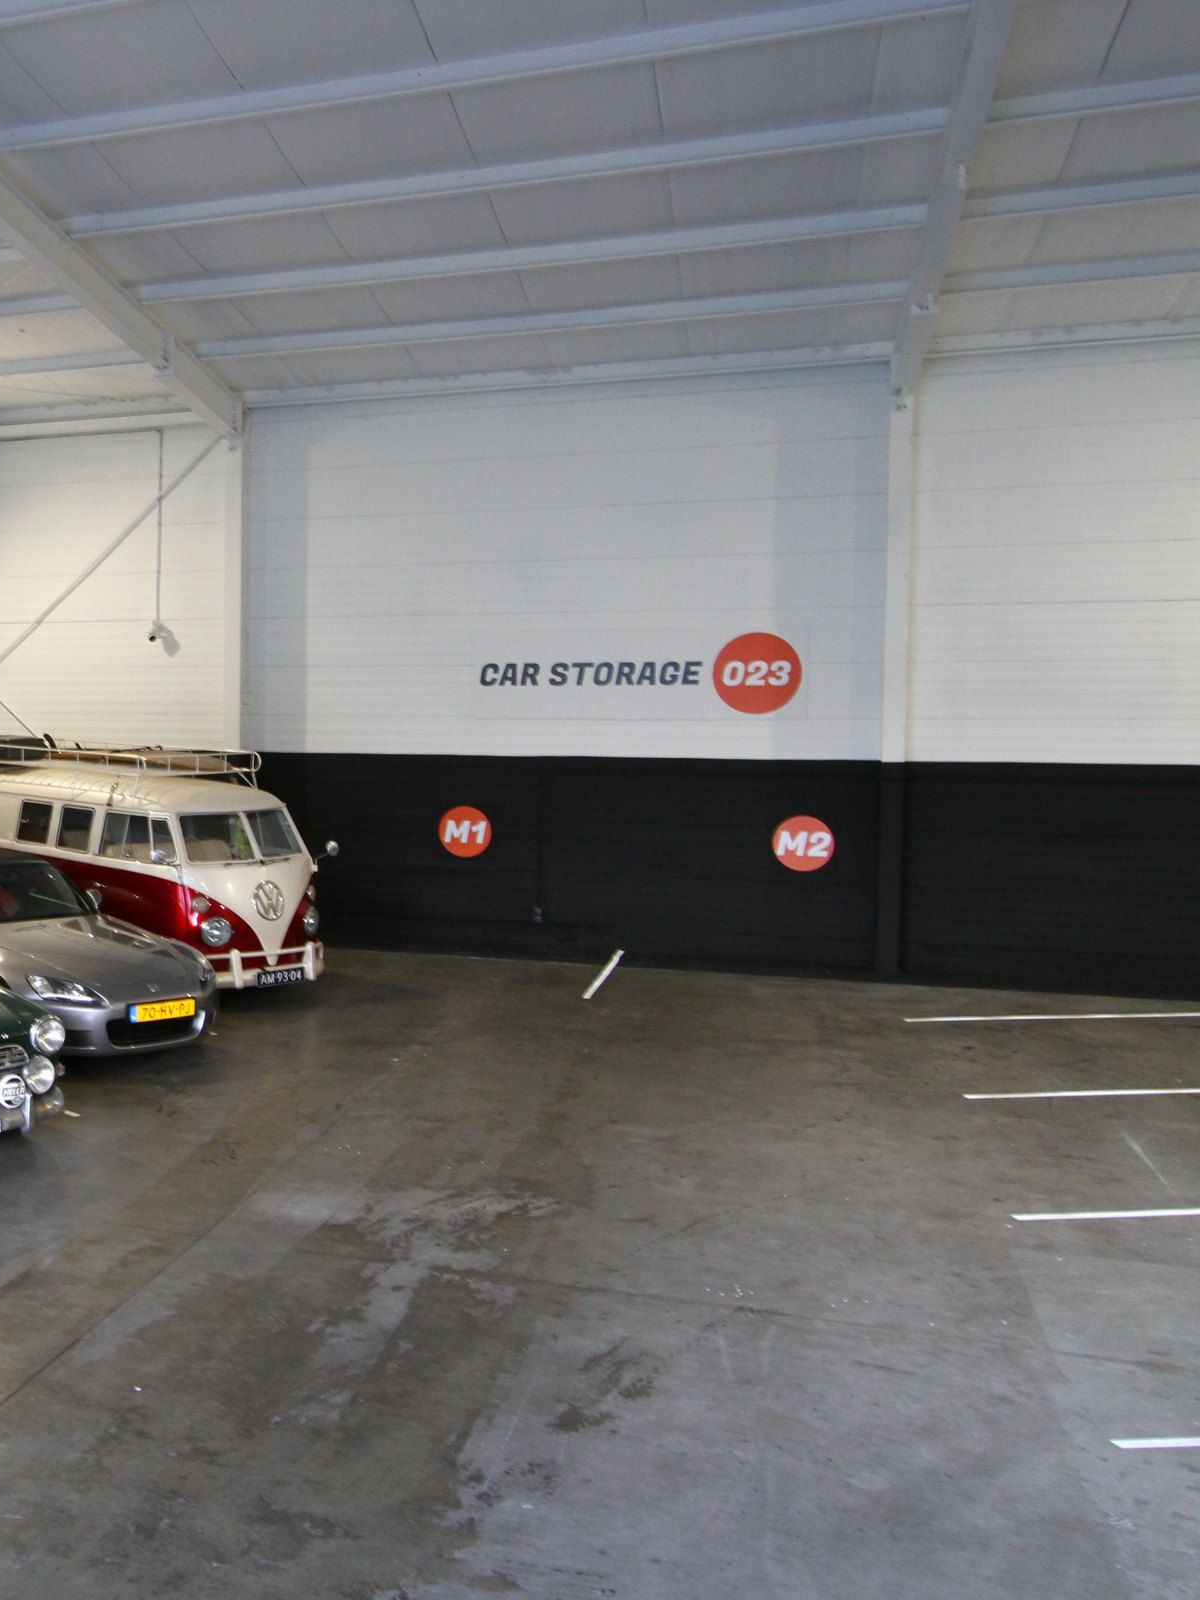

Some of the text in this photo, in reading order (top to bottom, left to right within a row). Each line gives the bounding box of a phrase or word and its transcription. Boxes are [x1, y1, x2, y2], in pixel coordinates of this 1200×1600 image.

[480, 661, 792, 686] CAR STORAGE 023
[444, 819, 487, 844] M1
[777, 830, 831, 857] M2
[260, 970, 302, 985] AM-93-04
[142, 1002, 191, 1018] 70-HV-PJ
[3, 1087, 26, 1098] HELLA
